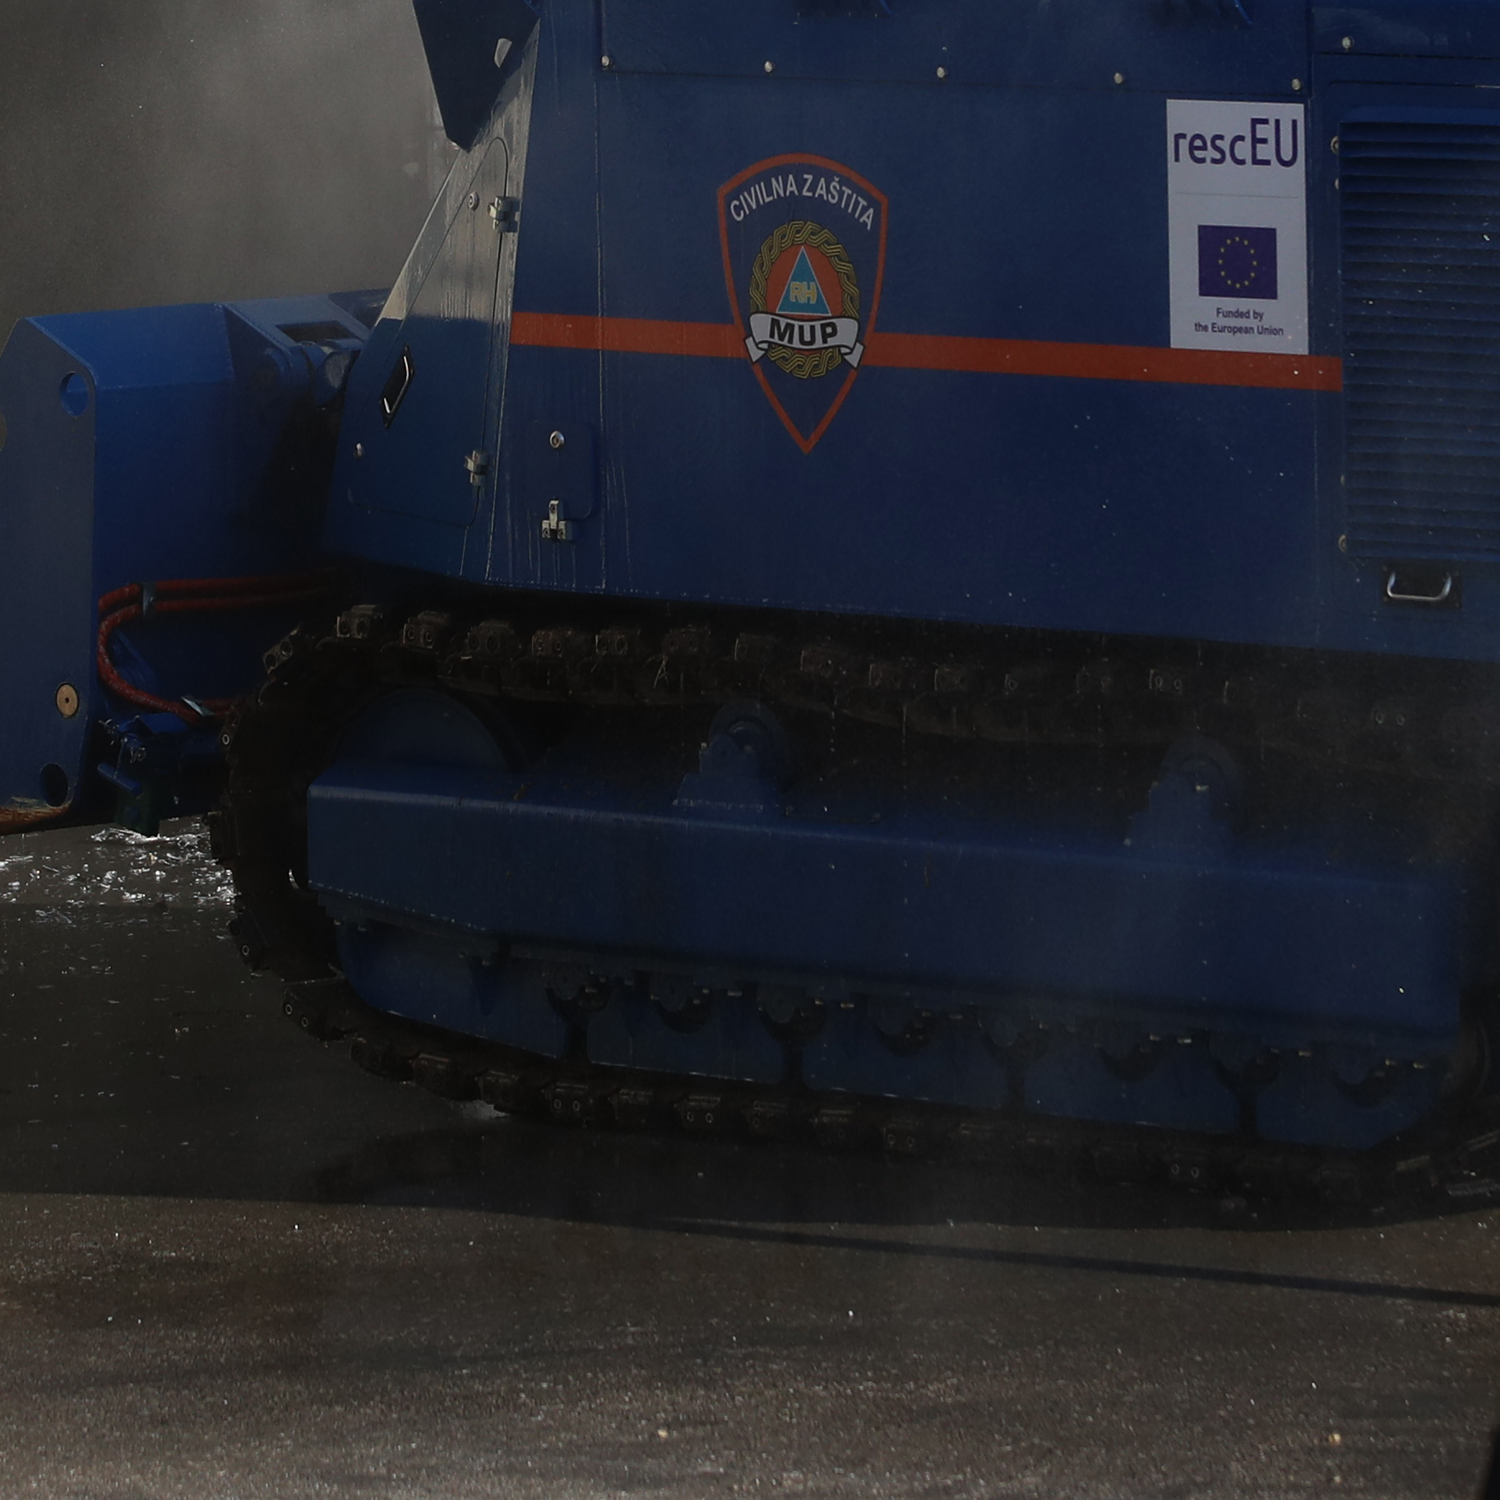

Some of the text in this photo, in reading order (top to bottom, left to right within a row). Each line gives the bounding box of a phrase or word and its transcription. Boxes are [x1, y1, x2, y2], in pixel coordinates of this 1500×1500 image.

[1173, 117, 1299, 168] rescEU
[730, 174, 875, 231] CIVILNA ZAŠTITA
[790, 282, 817, 304] RH
[1216, 307, 1264, 322] Funded by
[769, 317, 838, 346] MUP
[1194, 322, 1284, 336] the European Union
